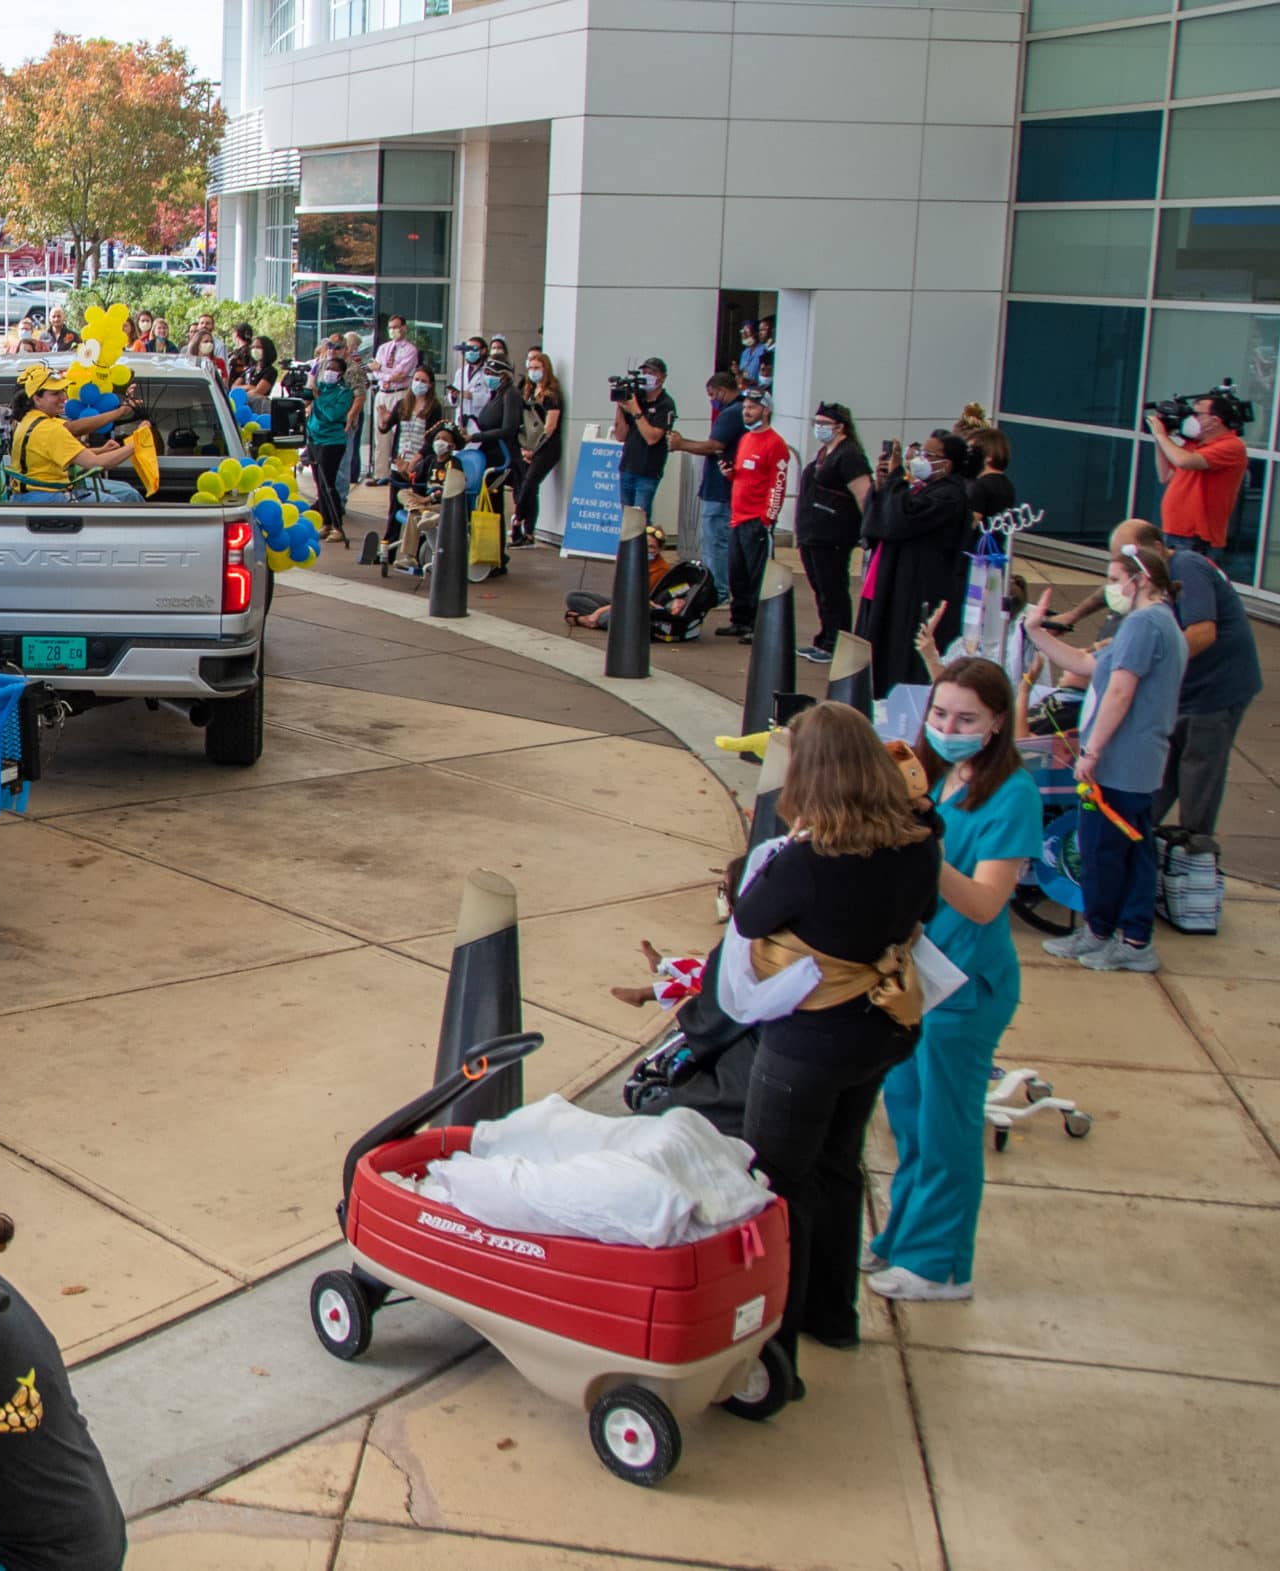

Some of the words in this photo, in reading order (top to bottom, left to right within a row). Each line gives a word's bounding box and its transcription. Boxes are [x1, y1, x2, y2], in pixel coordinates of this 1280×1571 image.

[592, 448, 615, 457] DROP
[592, 470, 609, 479] PICK
[594, 482, 616, 491] ONLY
[770, 472, 785, 520] Columbia
[572, 497, 597, 506] PLEASE
[578, 510, 601, 520] LEAVE
[46, 646, 62, 661] 28
[417, 1211, 466, 1233] RADIO
[487, 1235, 546, 1260] FLYER
